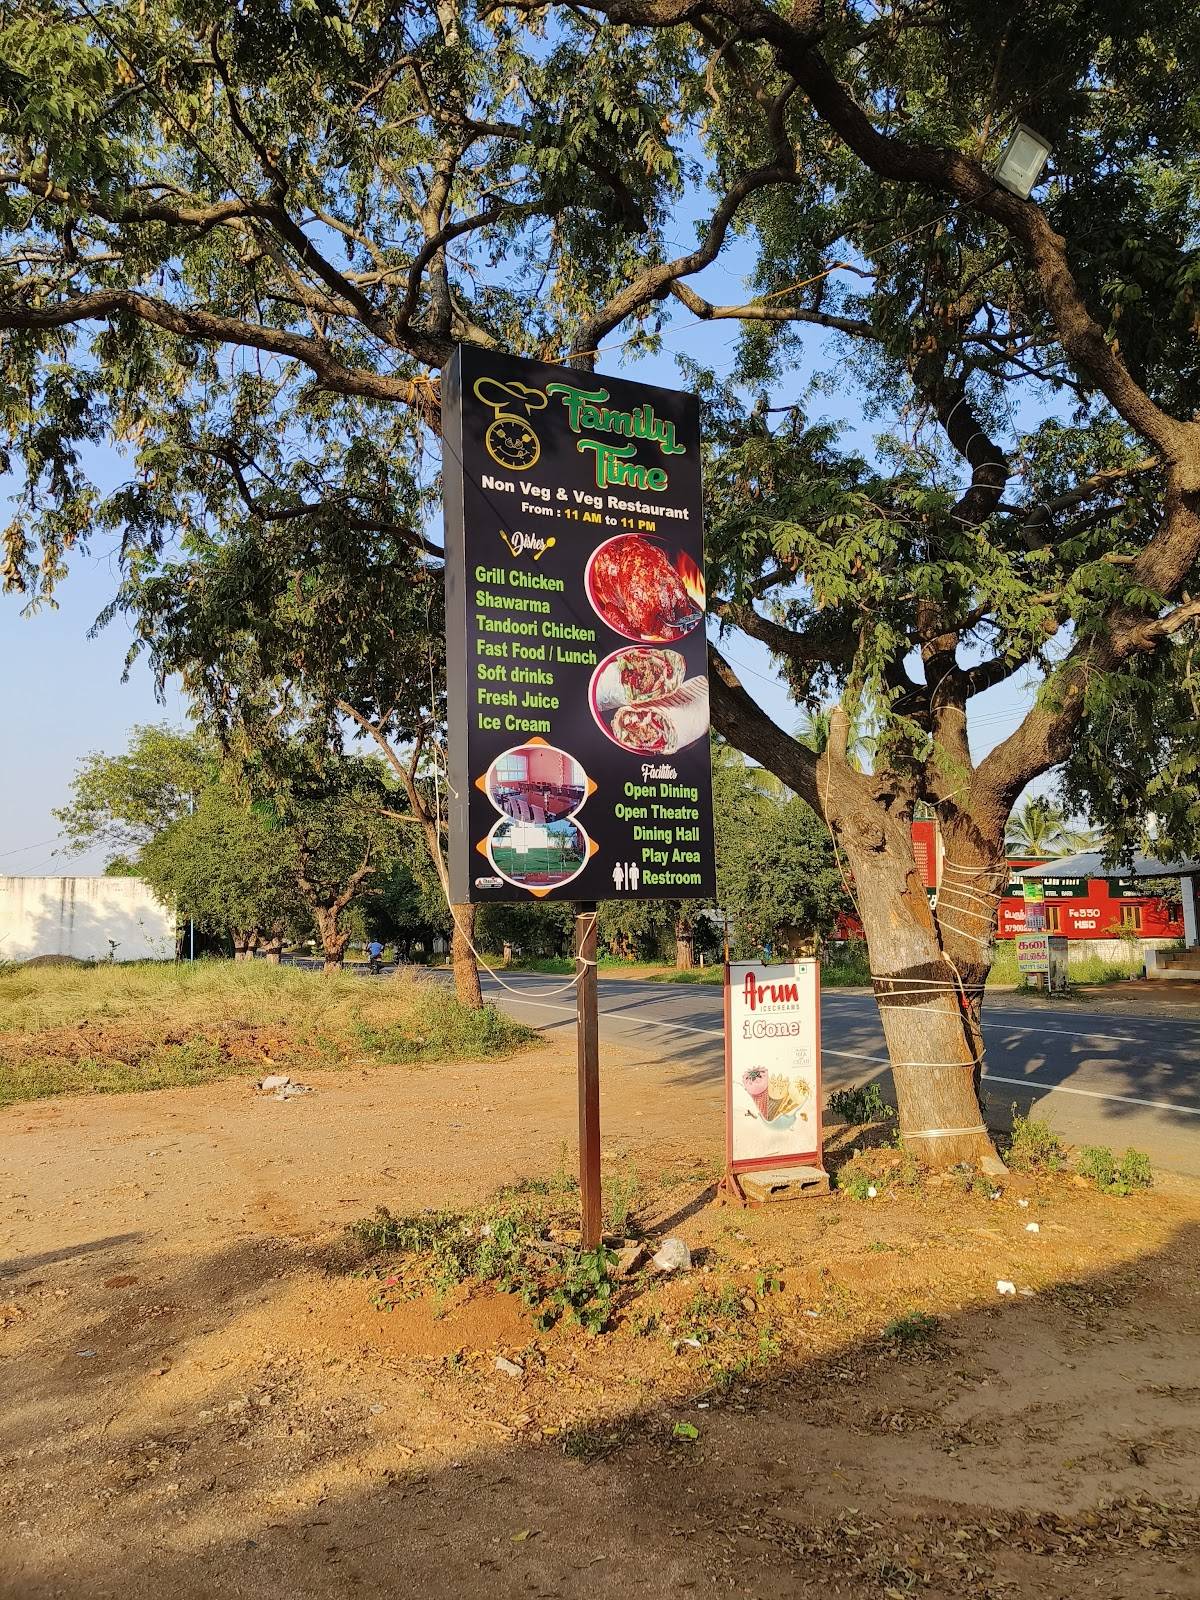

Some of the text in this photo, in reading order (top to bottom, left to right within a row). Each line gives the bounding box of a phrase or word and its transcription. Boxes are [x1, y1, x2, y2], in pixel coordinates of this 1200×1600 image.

[546, 383, 686, 455] Family
[577, 439, 668, 491] Time
[481, 475, 689, 520] Non Veg & Veg Restaurant
[521, 502, 553, 516] From
[564, 509, 579, 520] 11
[583, 511, 601, 524] AM
[605, 514, 617, 526] to
[621, 517, 634, 528] 11
[638, 519, 656, 531] PM
[511, 531, 545, 556] Dishes
[475, 565, 564, 592] Grill Chicken
[475, 590, 550, 614] Shawarma
[475, 614, 596, 642] Tandoori Chicken
[476, 639, 597, 665] Fast Food / Lunch
[477, 663, 554, 685] Soft drinks
[477, 688, 559, 709] Fresh Juice
[478, 713, 550, 733] Ice Cream
[624, 782, 698, 802] Open Dining
[615, 804, 699, 821] Open Theatre
[634, 826, 700, 844] Dining Hall
[642, 848, 700, 866] Play Area
[642, 870, 701, 885] Restroom
[742, 971, 799, 1011] Arun
